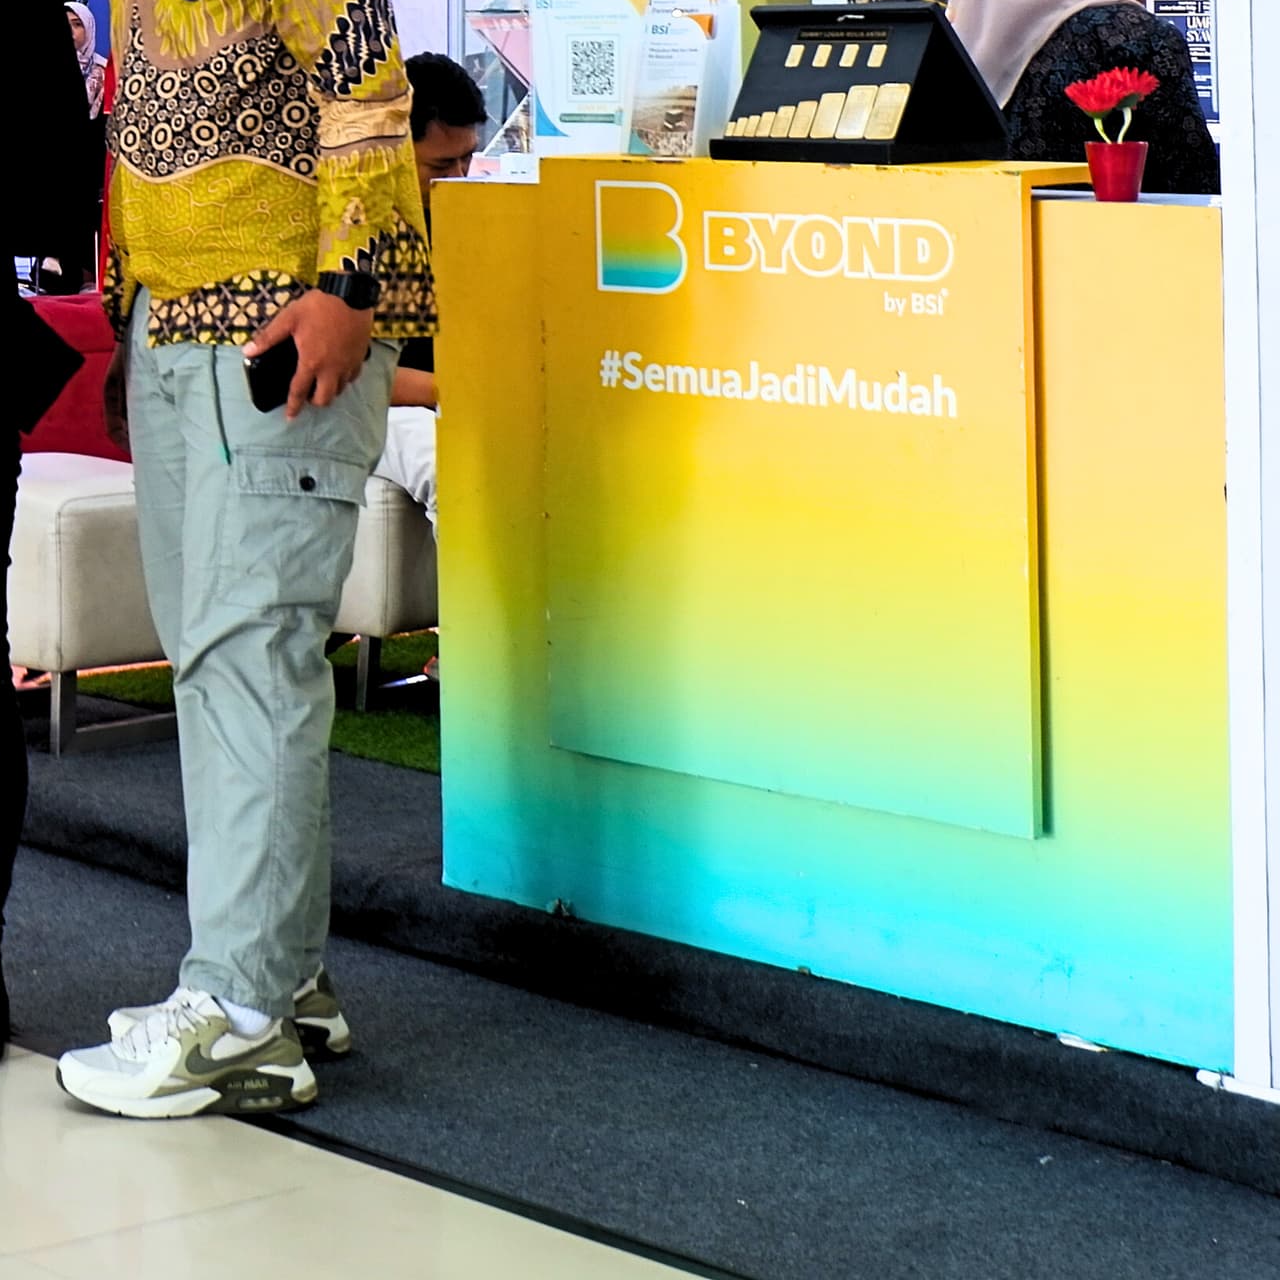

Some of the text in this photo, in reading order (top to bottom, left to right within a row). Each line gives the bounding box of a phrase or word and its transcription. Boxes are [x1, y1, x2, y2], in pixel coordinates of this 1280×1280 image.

[651, 23, 671, 35] BSI
[703, 210, 955, 282] BYOND
[884, 289, 949, 316] by BSI
[599, 350, 958, 418] #SemuaJadiMudah
